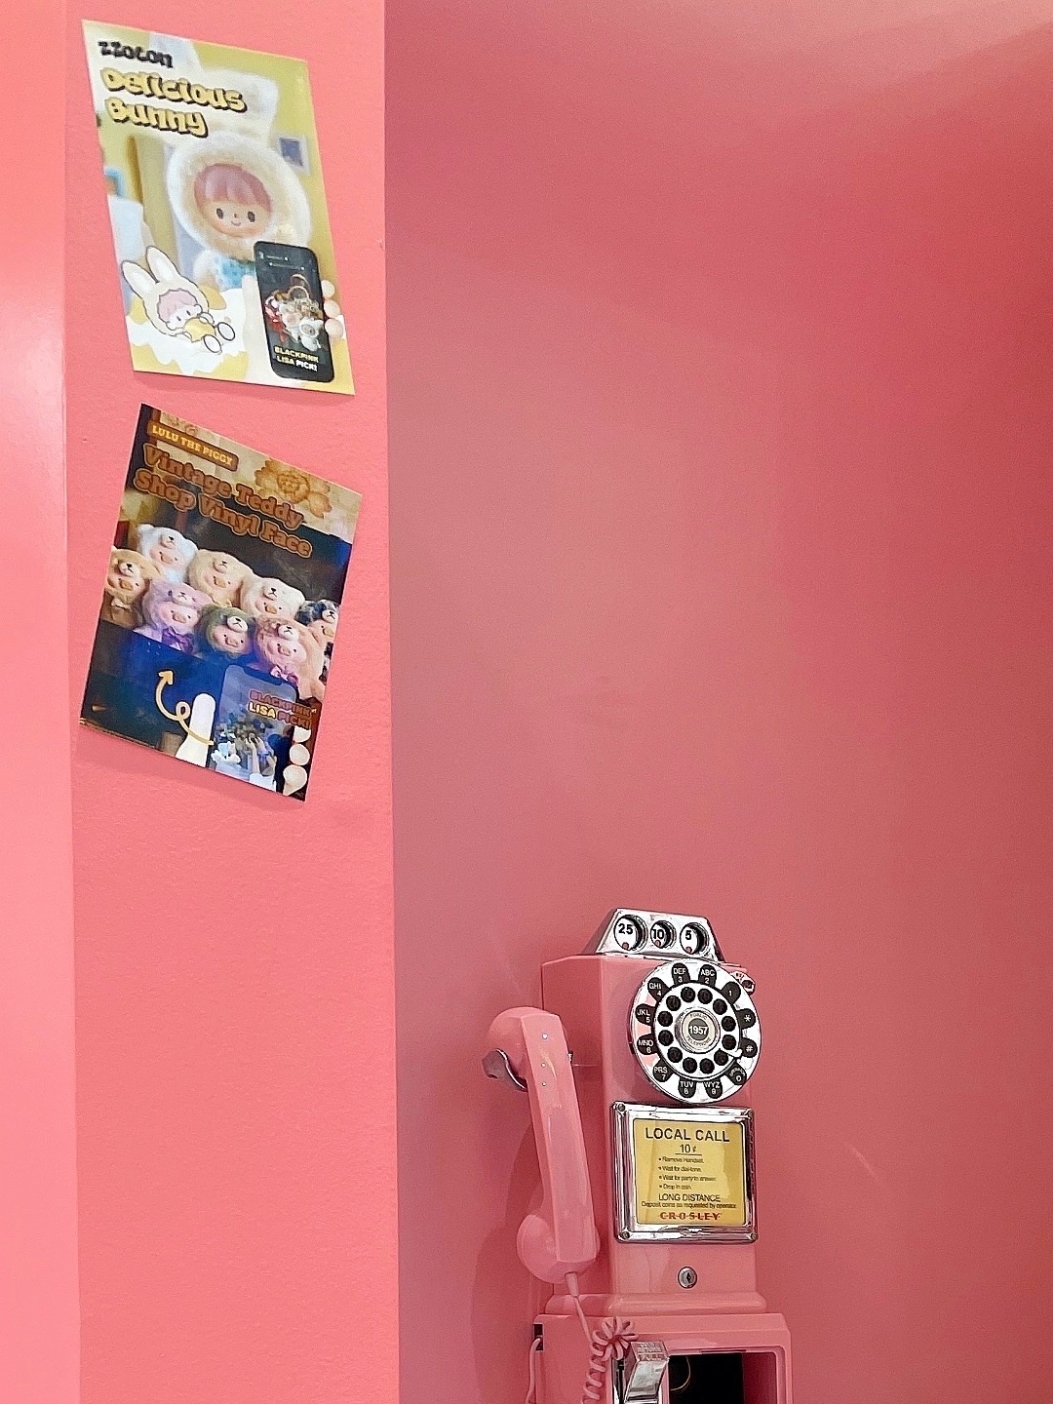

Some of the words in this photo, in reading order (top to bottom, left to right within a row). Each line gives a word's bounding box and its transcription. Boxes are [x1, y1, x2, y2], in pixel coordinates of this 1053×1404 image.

[100, 68, 248, 113] Delicious
[105, 96, 209, 138] Bunny
[277, 355, 295, 367] LISA
[152, 425, 179, 443] LULU
[181, 437, 201, 452] THE
[203, 444, 233, 467] PIGGY
[143, 443, 232, 499] Vintage
[235, 483, 304, 531] Teddy
[198, 493, 261, 537] Vinyl
[259, 520, 313, 558] Face
[249, 701, 276, 719] LISA
[618, 922, 634, 935] 25
[651, 928, 665, 940] 10
[685, 930, 692, 941] 5
[673, 967, 687, 975] DEF
[700, 969, 715, 977] ABC
[649, 982, 662, 990] GHI
[637, 1009, 651, 1017] JKL
[689, 1025, 709, 1035] 1957
[638, 1039, 654, 1047] MNO
[653, 1066, 668, 1074] PRS
[645, 1127, 691, 1141] LOCAL
[695, 1129, 730, 1142] CALL
[658, 1193, 681, 1201] LONG
[682, 1194, 721, 1203] DISTANCE
